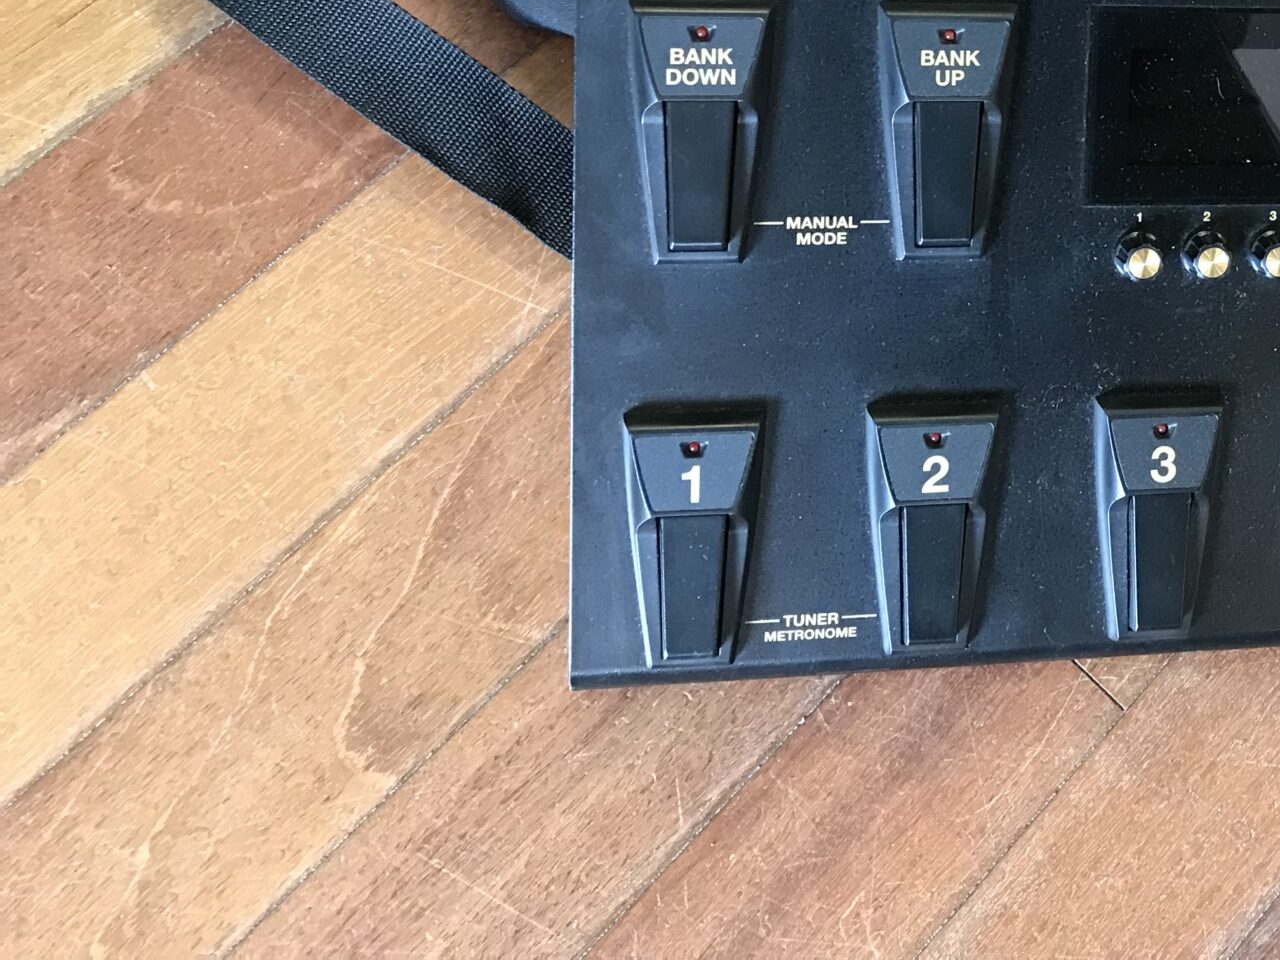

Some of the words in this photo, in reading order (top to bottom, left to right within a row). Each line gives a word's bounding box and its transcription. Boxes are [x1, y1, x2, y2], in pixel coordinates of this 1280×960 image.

[669, 47, 734, 65] BANK
[920, 49, 981, 67] BANK
[665, 68, 737, 86] DOWN
[935, 69, 965, 87] UP
[786, 215, 859, 230] MANUAL
[1136, 212, 1143, 223] 1
[1202, 211, 1211, 222] 2
[1269, 210, 1277, 221] 3
[796, 231, 848, 246] MODE
[1150, 445, 1177, 484] 3
[921, 455, 950, 494] 2
[681, 465, 701, 504] 1
[782, 612, 839, 628] TUNER
[763, 627, 858, 643] METRONOME
